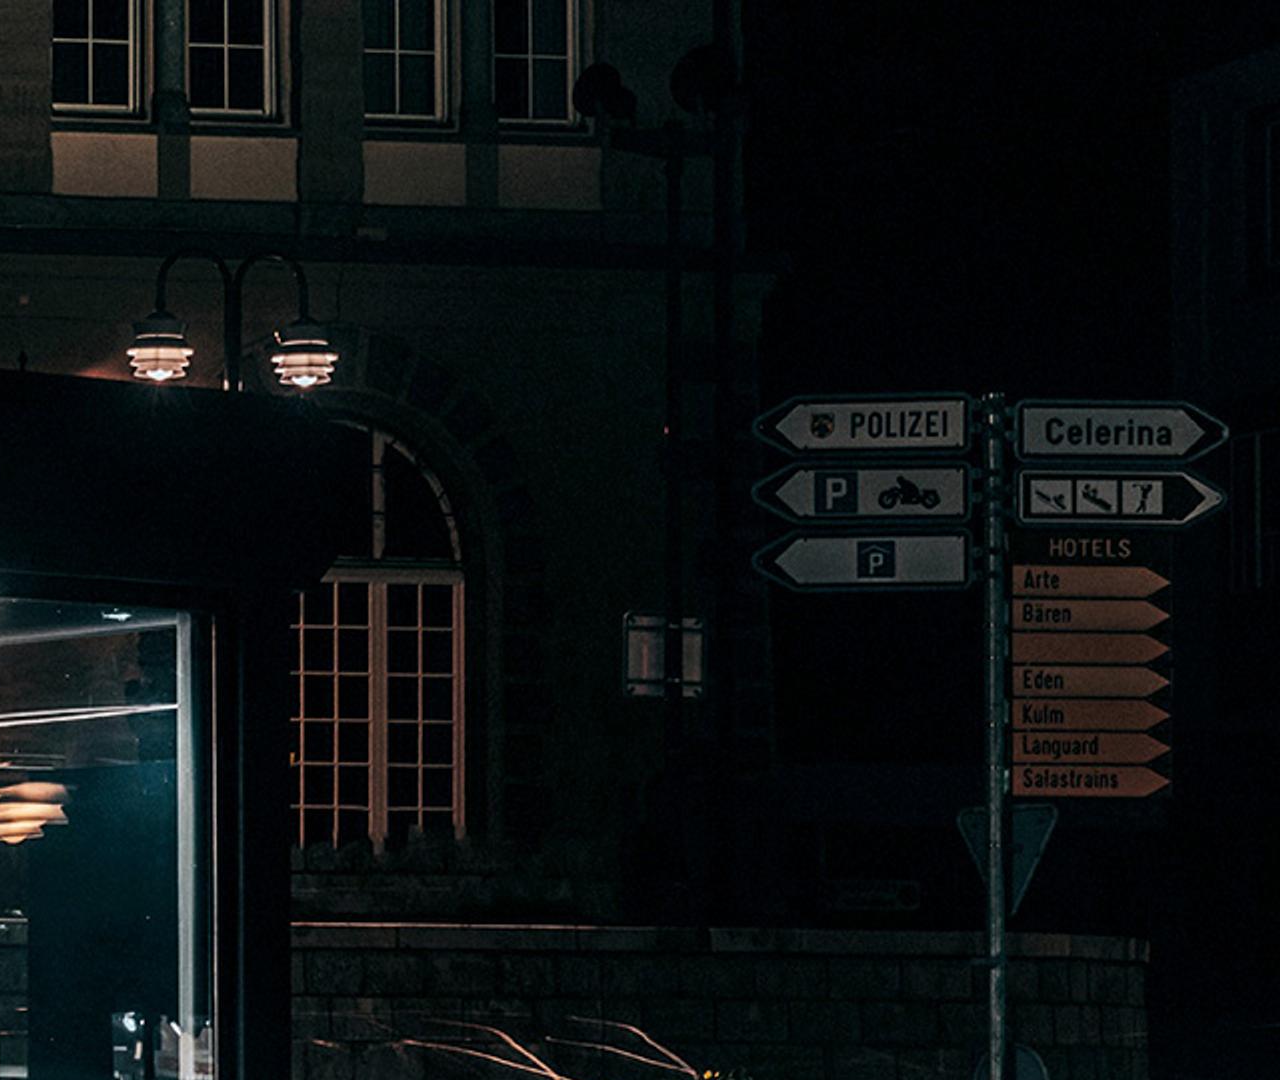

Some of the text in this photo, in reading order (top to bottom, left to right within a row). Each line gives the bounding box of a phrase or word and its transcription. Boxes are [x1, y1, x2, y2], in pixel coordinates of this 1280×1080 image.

[850, 409, 950, 440] POLIZEI
[1044, 416, 1173, 446] Celerina
[826, 477, 848, 510] P
[1049, 538, 1132, 559] HOTELS
[1024, 570, 1060, 589] Arte
[1023, 603, 1072, 623] Bären
[1023, 670, 1064, 689] Eden
[1023, 704, 1065, 724] Kulm
[1023, 736, 1099, 760] Languard
[1023, 768, 1119, 788] Salastrains
